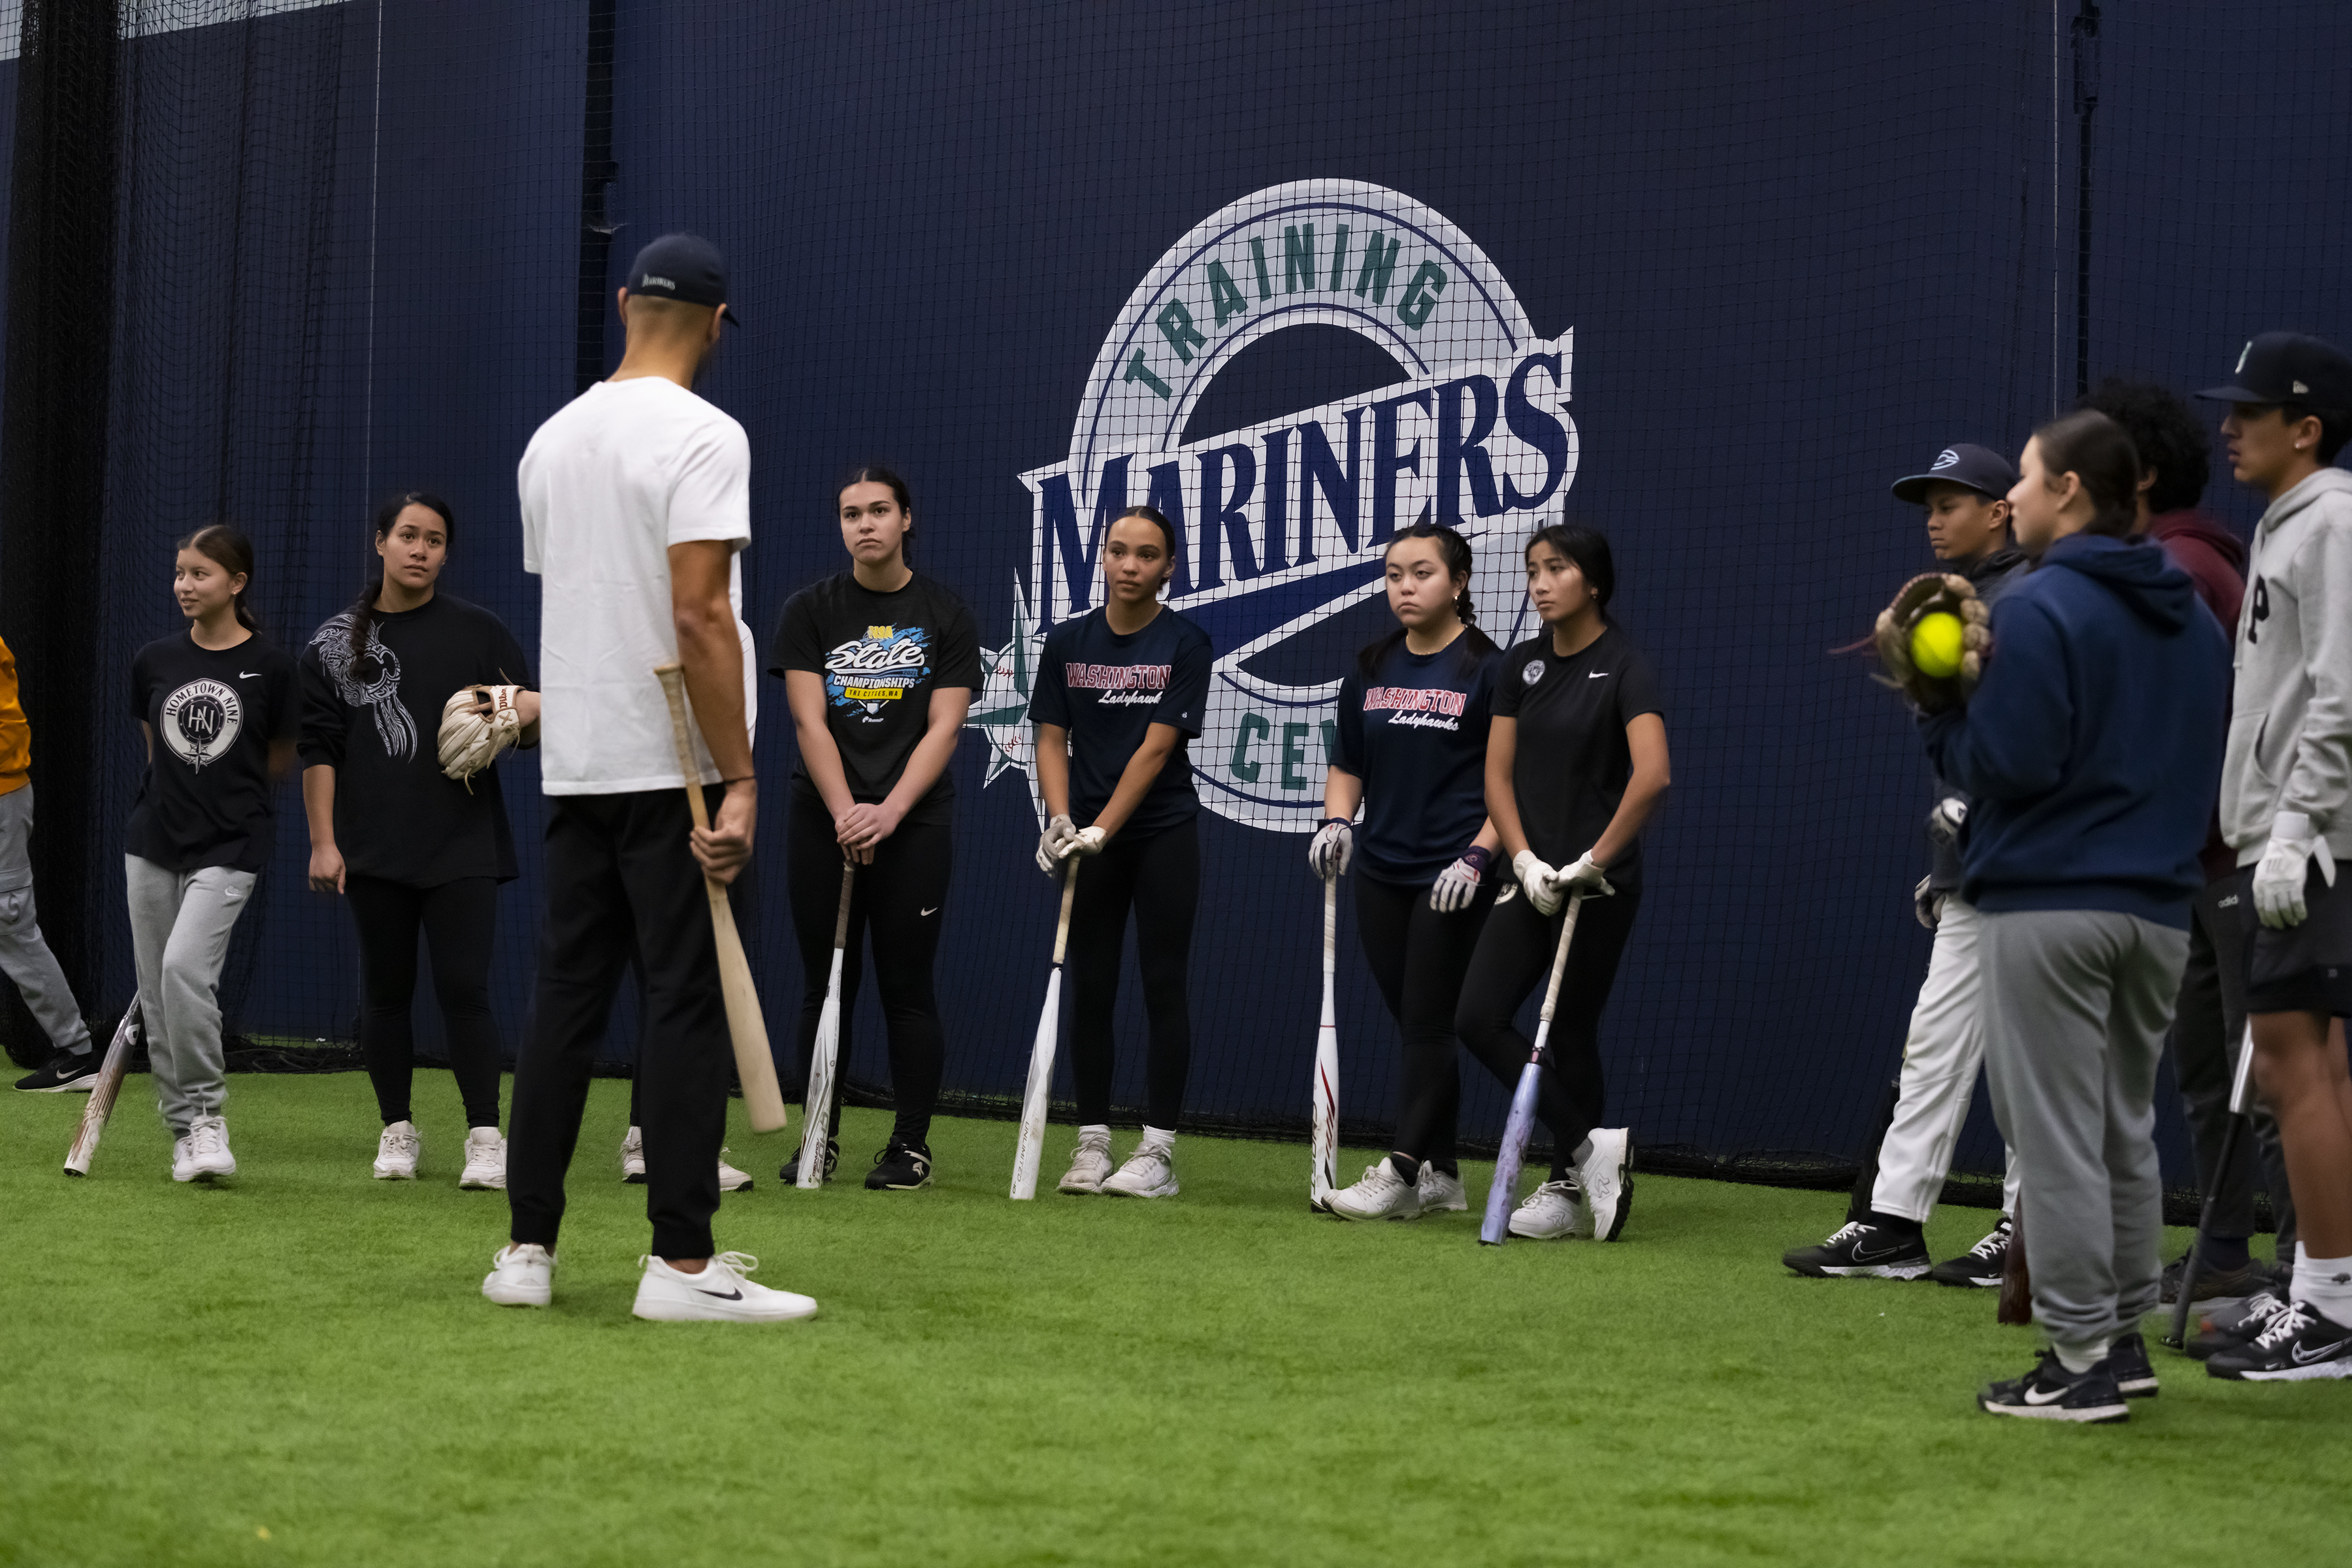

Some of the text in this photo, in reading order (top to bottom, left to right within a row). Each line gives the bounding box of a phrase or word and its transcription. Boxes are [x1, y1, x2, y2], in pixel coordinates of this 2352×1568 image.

[1123, 222, 1447, 401] TRAINING
[825, 638, 925, 670] State
[833, 675, 915, 689] CHAMPIONSHIPS
[1066, 662, 1171, 689] WASHINGTON
[165, 682, 238, 725] HOMETOWN NINE
[1098, 689, 1164, 707] Ladyhawk
[1363, 687, 1467, 717] WASHINGTON
[1388, 710, 1460, 731] Ladyhawks
[2217, 894, 2239, 908] adid
[1017, 1121, 1030, 1182] UNLIMITED
